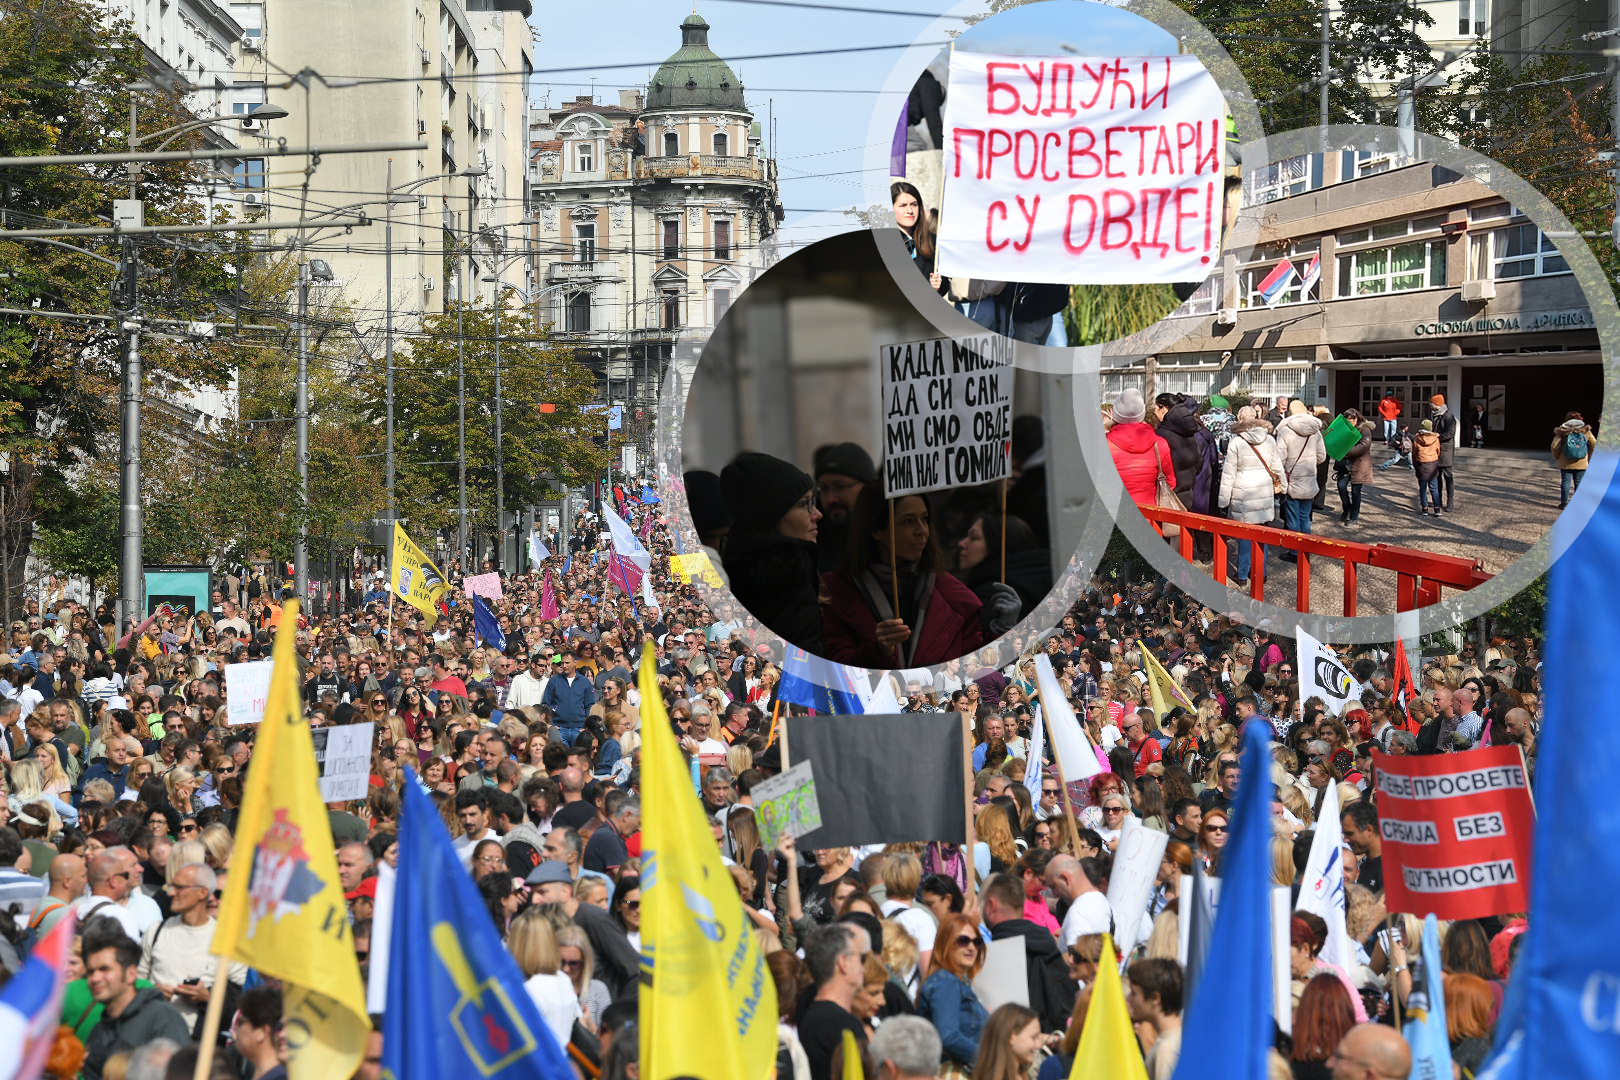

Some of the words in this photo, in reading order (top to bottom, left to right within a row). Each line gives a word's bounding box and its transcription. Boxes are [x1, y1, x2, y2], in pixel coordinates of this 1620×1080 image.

[986, 57, 1171, 118] БУДУЋИ
[952, 119, 1219, 181] ПРОСВЕТАРИ
[985, 194, 1041, 252] СУ
[1063, 182, 1213, 264] ОВДЕ!
[1414, 320, 1474, 336] ОСНОВНА
[1476, 318, 1520, 332] ШКОЛА
[889, 340, 945, 383] КАДА
[888, 383, 920, 419] ДА
[927, 377, 952, 410] СИ
[887, 419, 916, 454] МИ
[924, 414, 961, 447] СМО
[973, 404, 1010, 443] ОВДЕ
[886, 455, 914, 492] ИМА
[915, 451, 939, 487] НАС
[945, 440, 1006, 485] ГОМИЛА
[1413, 768, 1524, 797] ПРОСВЕТЕ
[1382, 820, 1437, 842] СРБИЈА
[1457, 815, 1502, 837] БЕЗ
